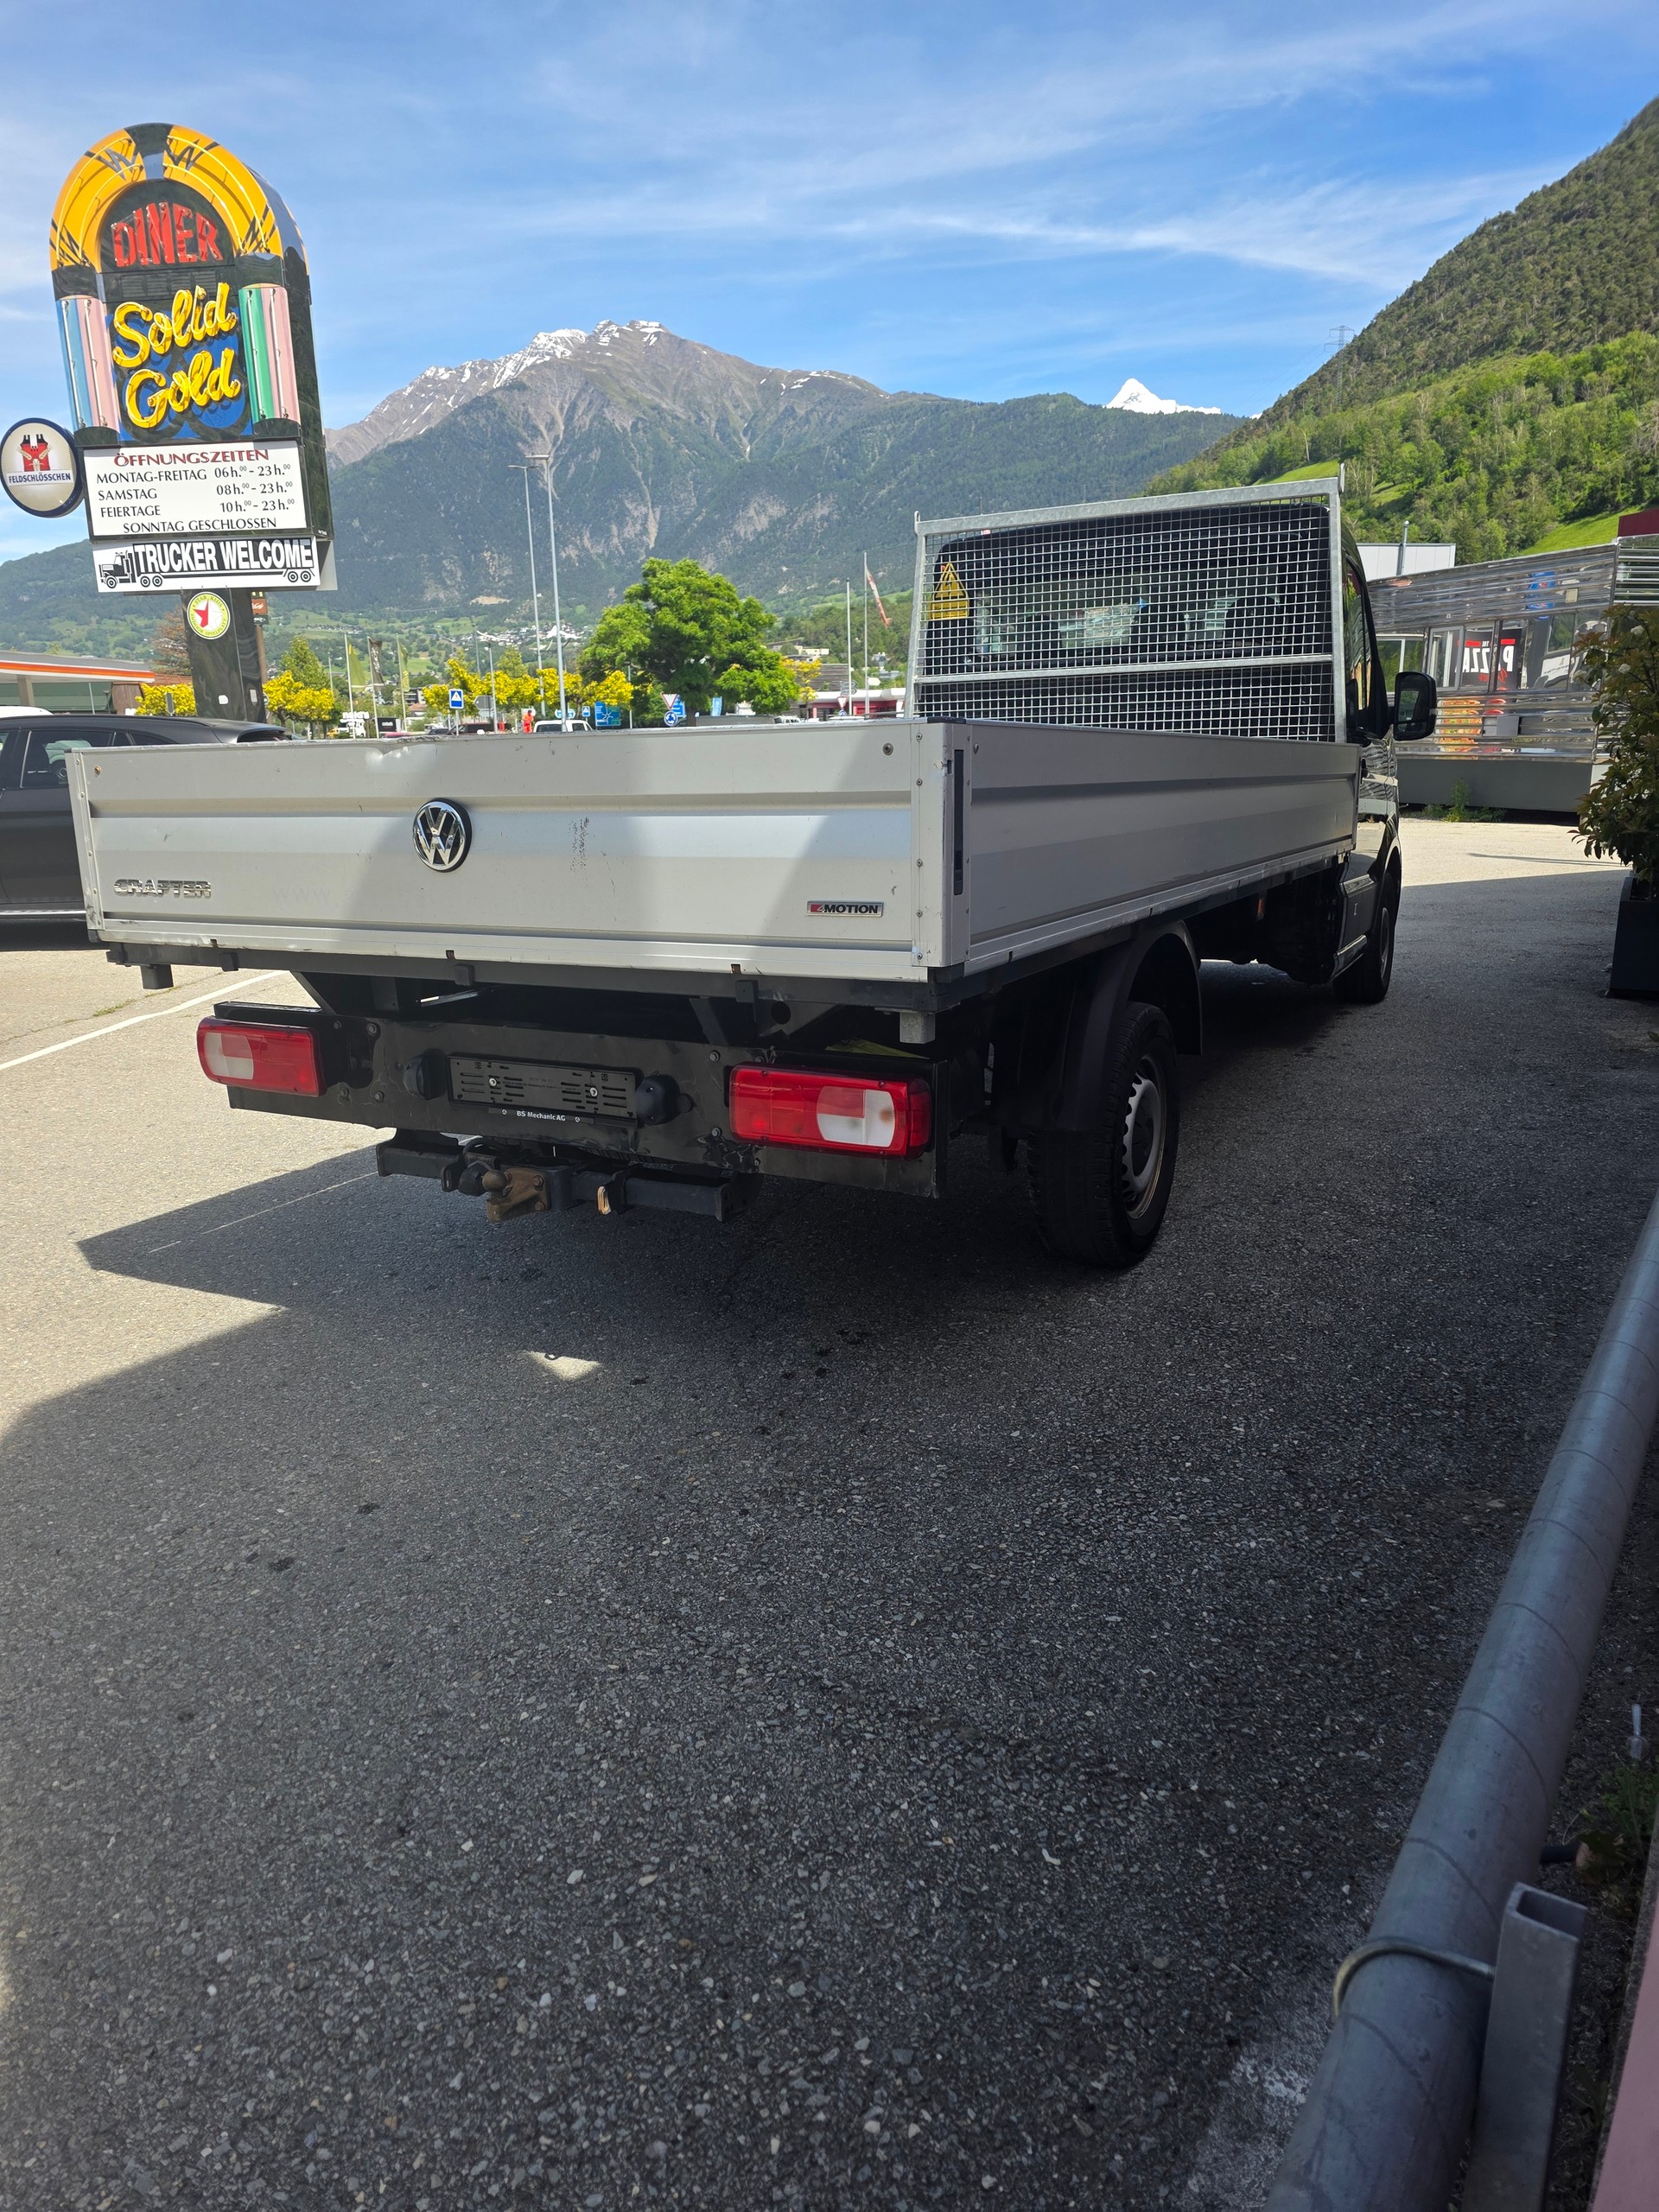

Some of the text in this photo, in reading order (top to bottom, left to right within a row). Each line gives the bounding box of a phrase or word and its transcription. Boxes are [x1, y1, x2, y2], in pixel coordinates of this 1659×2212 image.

[111, 200, 223, 267] DINER
[112, 282, 238, 368] Solid
[125, 347, 241, 429] Gold
[114, 449, 269, 467] ÖFFNUNGSZEITEN
[9, 473, 71, 483] FELDSCHLÖSSCHEN
[97, 469, 207, 484] MONTAG-FREITAG
[98, 488, 157, 501] SAMSTAG
[100, 505, 162, 518] FEIERTAGE
[123, 518, 276, 533] SONNTAG GESCHLOSSEN
[133, 538, 314, 573] TRUCKER WELCOME
[114, 879, 211, 898] CRAFTER
[527, 1111, 556, 1121] Mechanic
